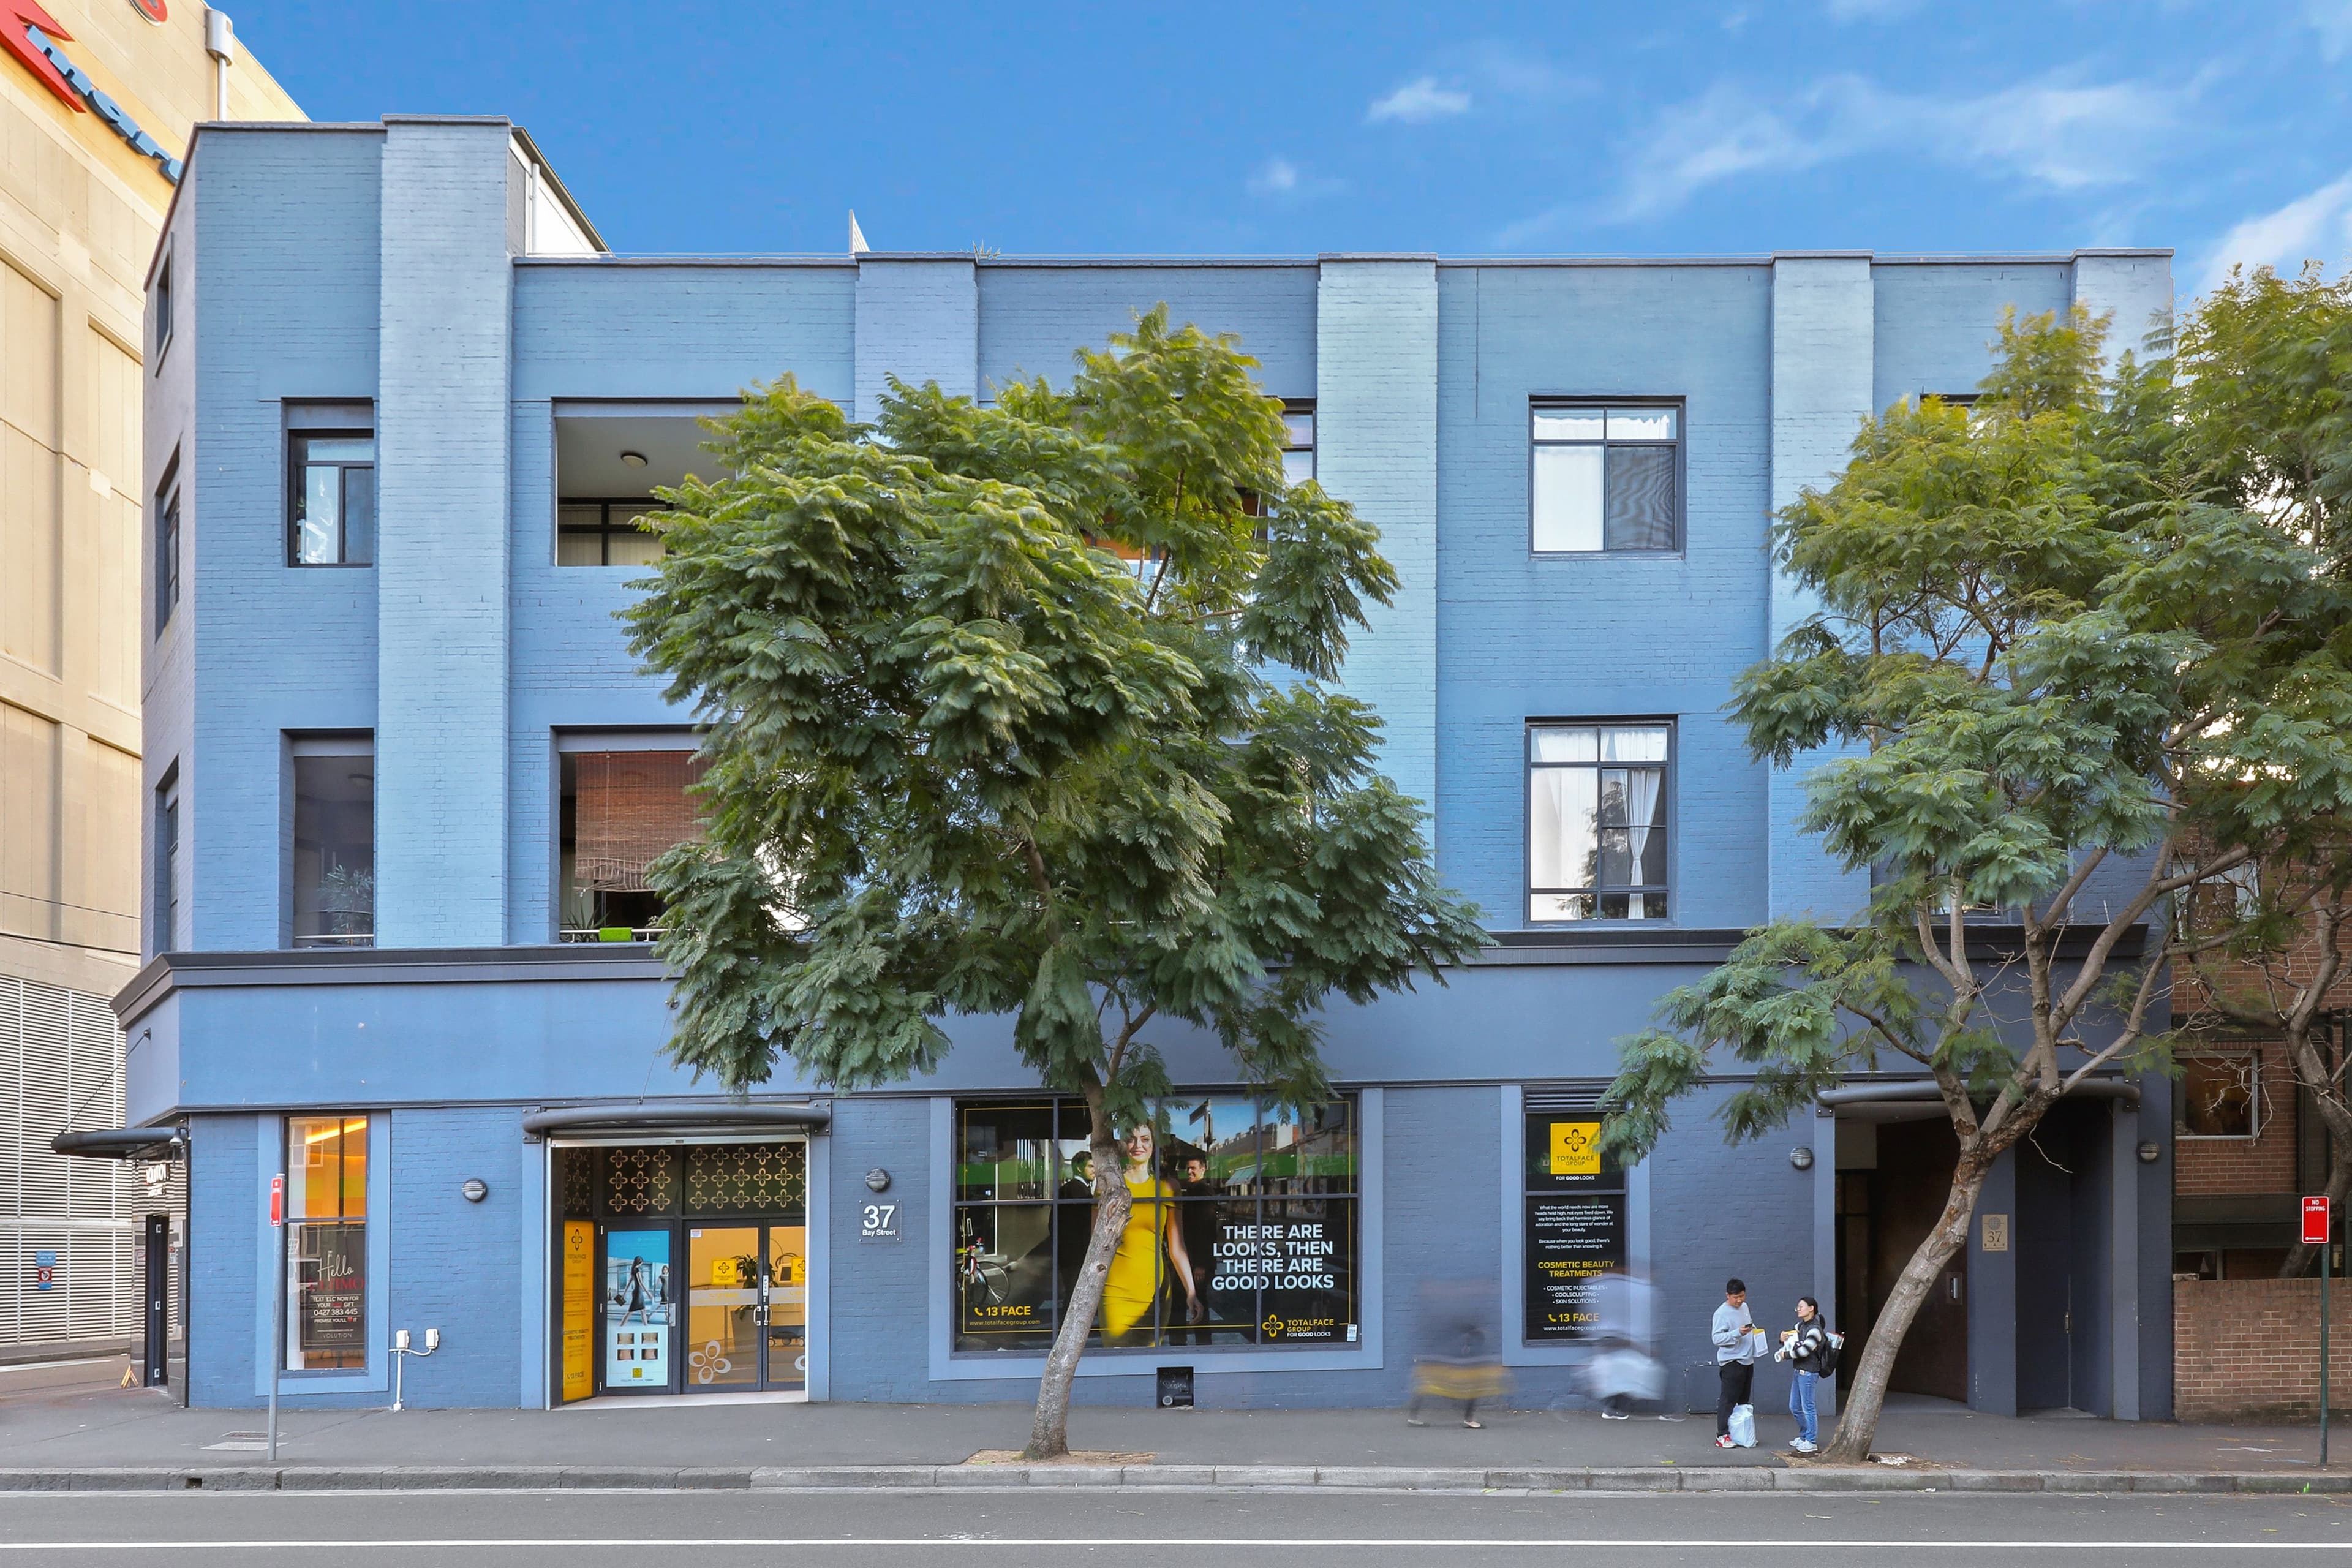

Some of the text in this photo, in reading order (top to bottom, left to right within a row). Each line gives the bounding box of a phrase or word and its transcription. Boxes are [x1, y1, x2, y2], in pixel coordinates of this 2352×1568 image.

[864, 1205, 895, 1229] 37
[1223, 1224, 1322, 1240] THERE ARE
[1988, 1231, 2002, 1242] 37
[1213, 1241, 1333, 1257] LOOKS, THEN
[317, 1250, 353, 1281] Hello
[1223, 1257, 1322, 1273] THERE ARE
[1212, 1275, 1334, 1291] GOOD LOOKS
[986, 1306, 1031, 1316] 13 FACE
[1573, 1313, 1599, 1322] FACE
